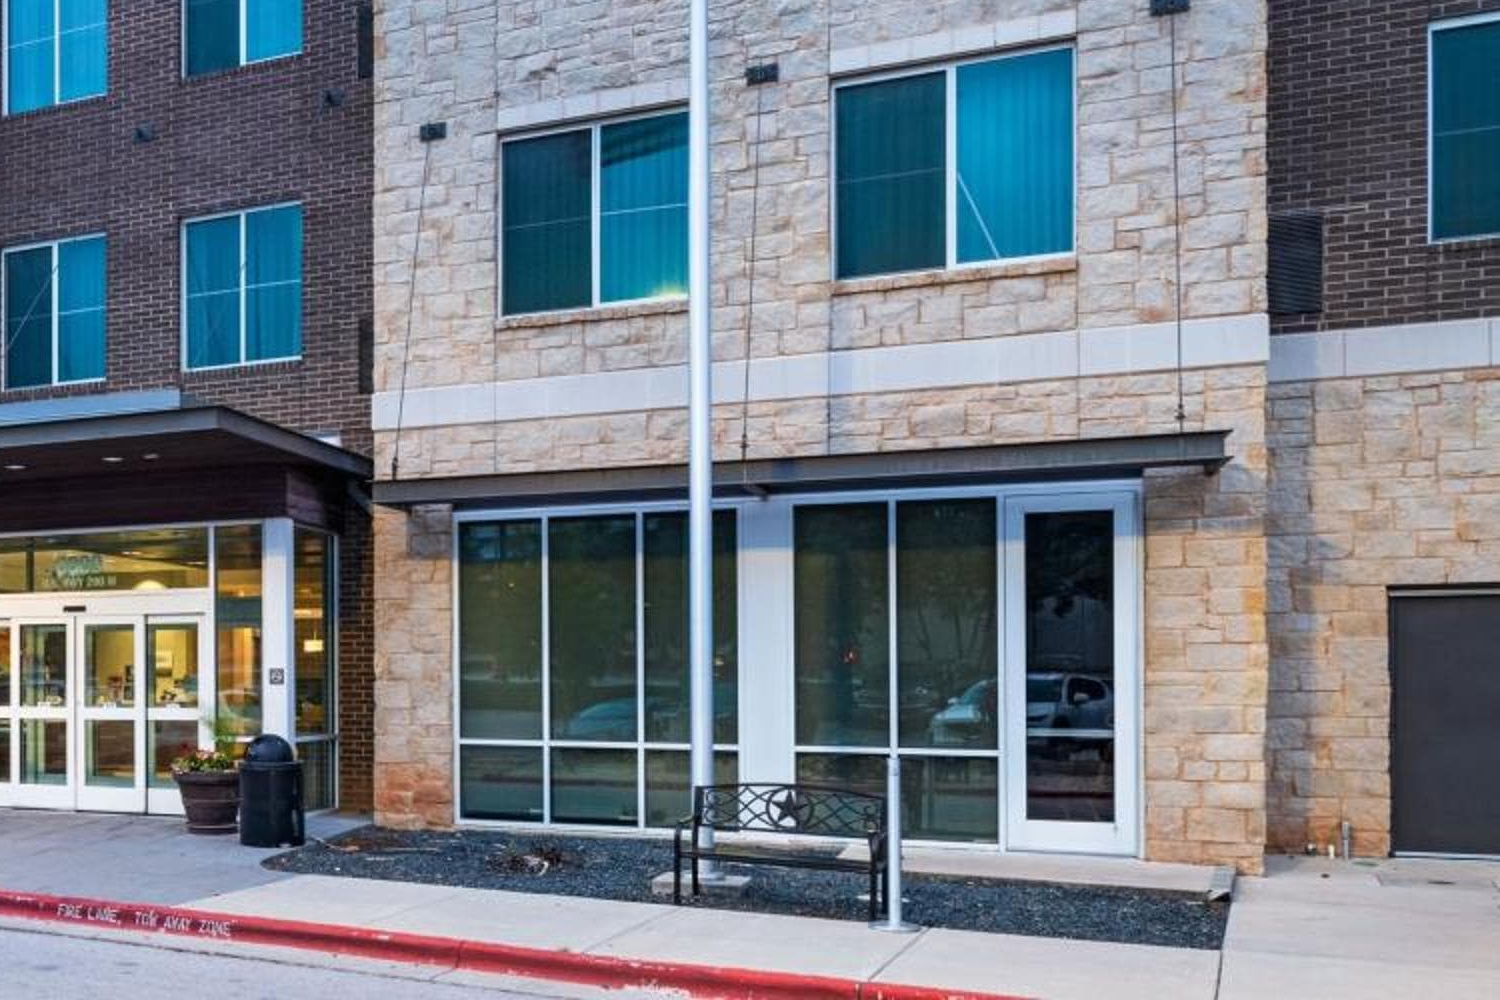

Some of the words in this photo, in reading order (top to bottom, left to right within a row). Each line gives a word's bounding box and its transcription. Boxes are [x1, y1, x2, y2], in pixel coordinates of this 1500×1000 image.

[56, 903, 83, 920] FIRE
[135, 910, 159, 928] TOW
[163, 915, 193, 932] AWAY
